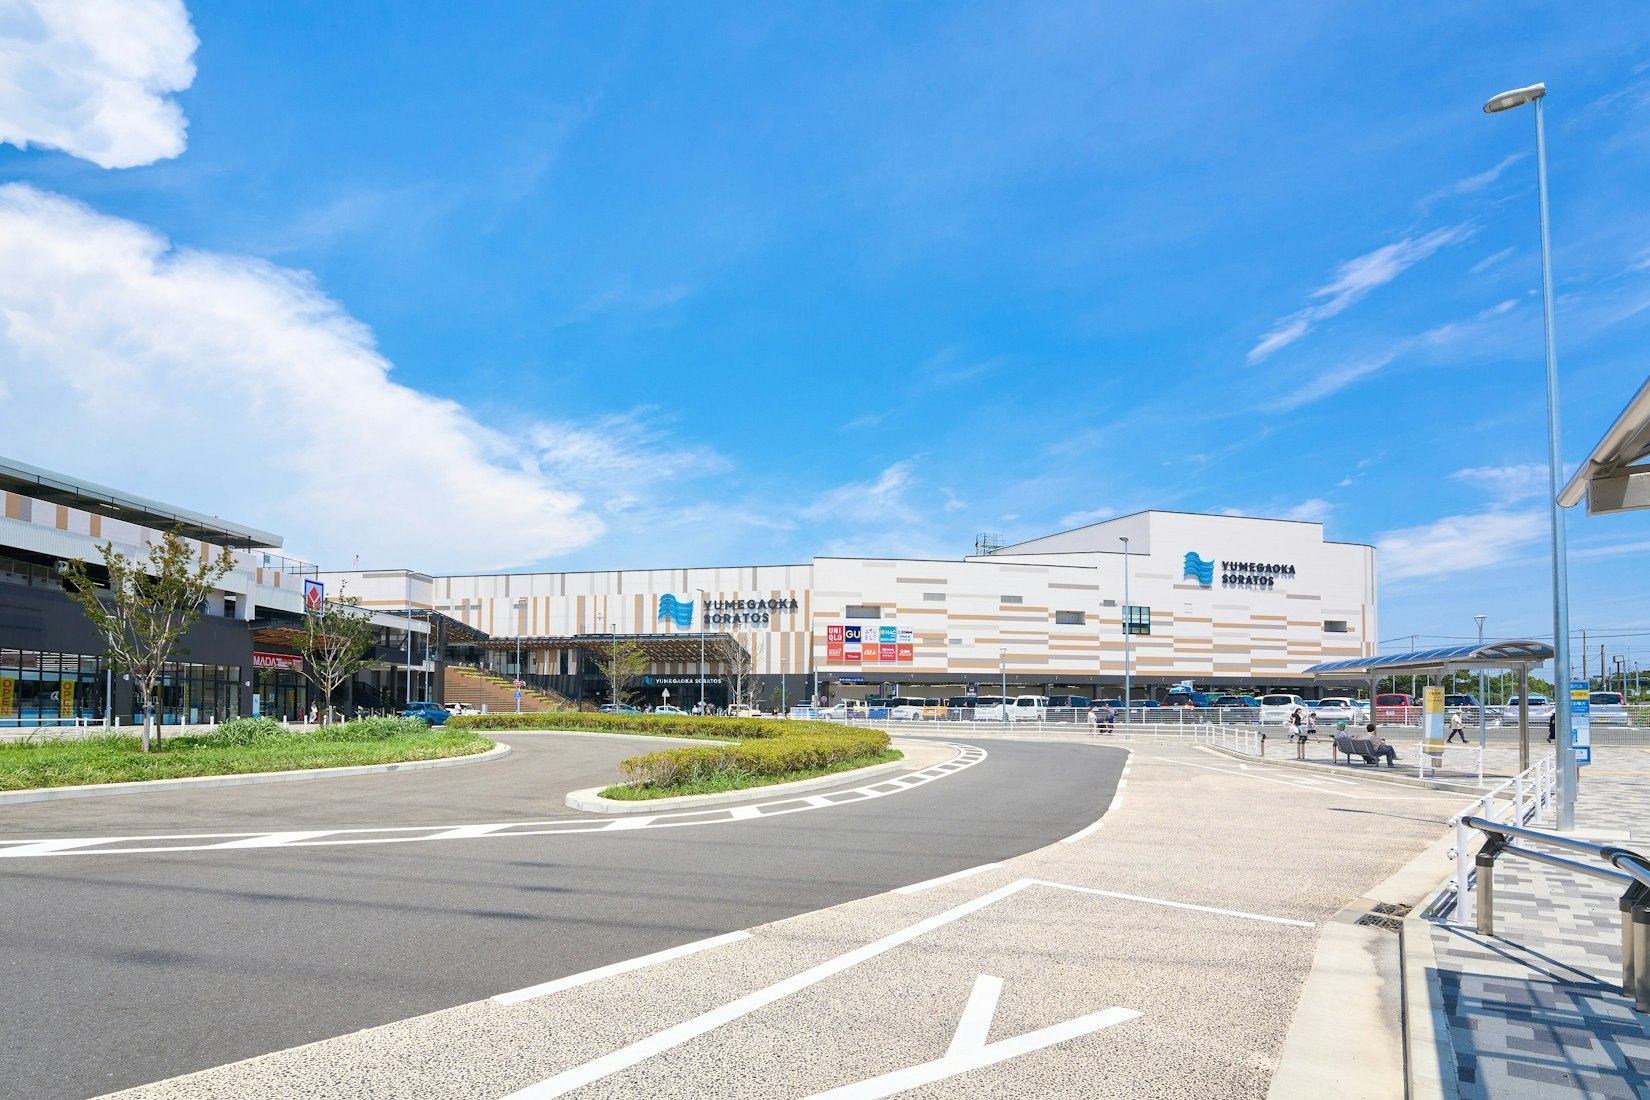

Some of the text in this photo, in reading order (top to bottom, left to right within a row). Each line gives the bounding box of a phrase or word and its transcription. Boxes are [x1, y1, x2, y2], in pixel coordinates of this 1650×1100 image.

[1222, 561, 1295, 574] YUMEGAOKA
[1221, 574, 1274, 586] SORATOS
[704, 598, 798, 610] YUMEGAOKA
[703, 612, 769, 624] SORATOS
[845, 630, 860, 638] GU
[253, 655, 276, 667] MADA
[2, 679, 12, 715] OPEN
[63, 682, 72, 716] OPEN
